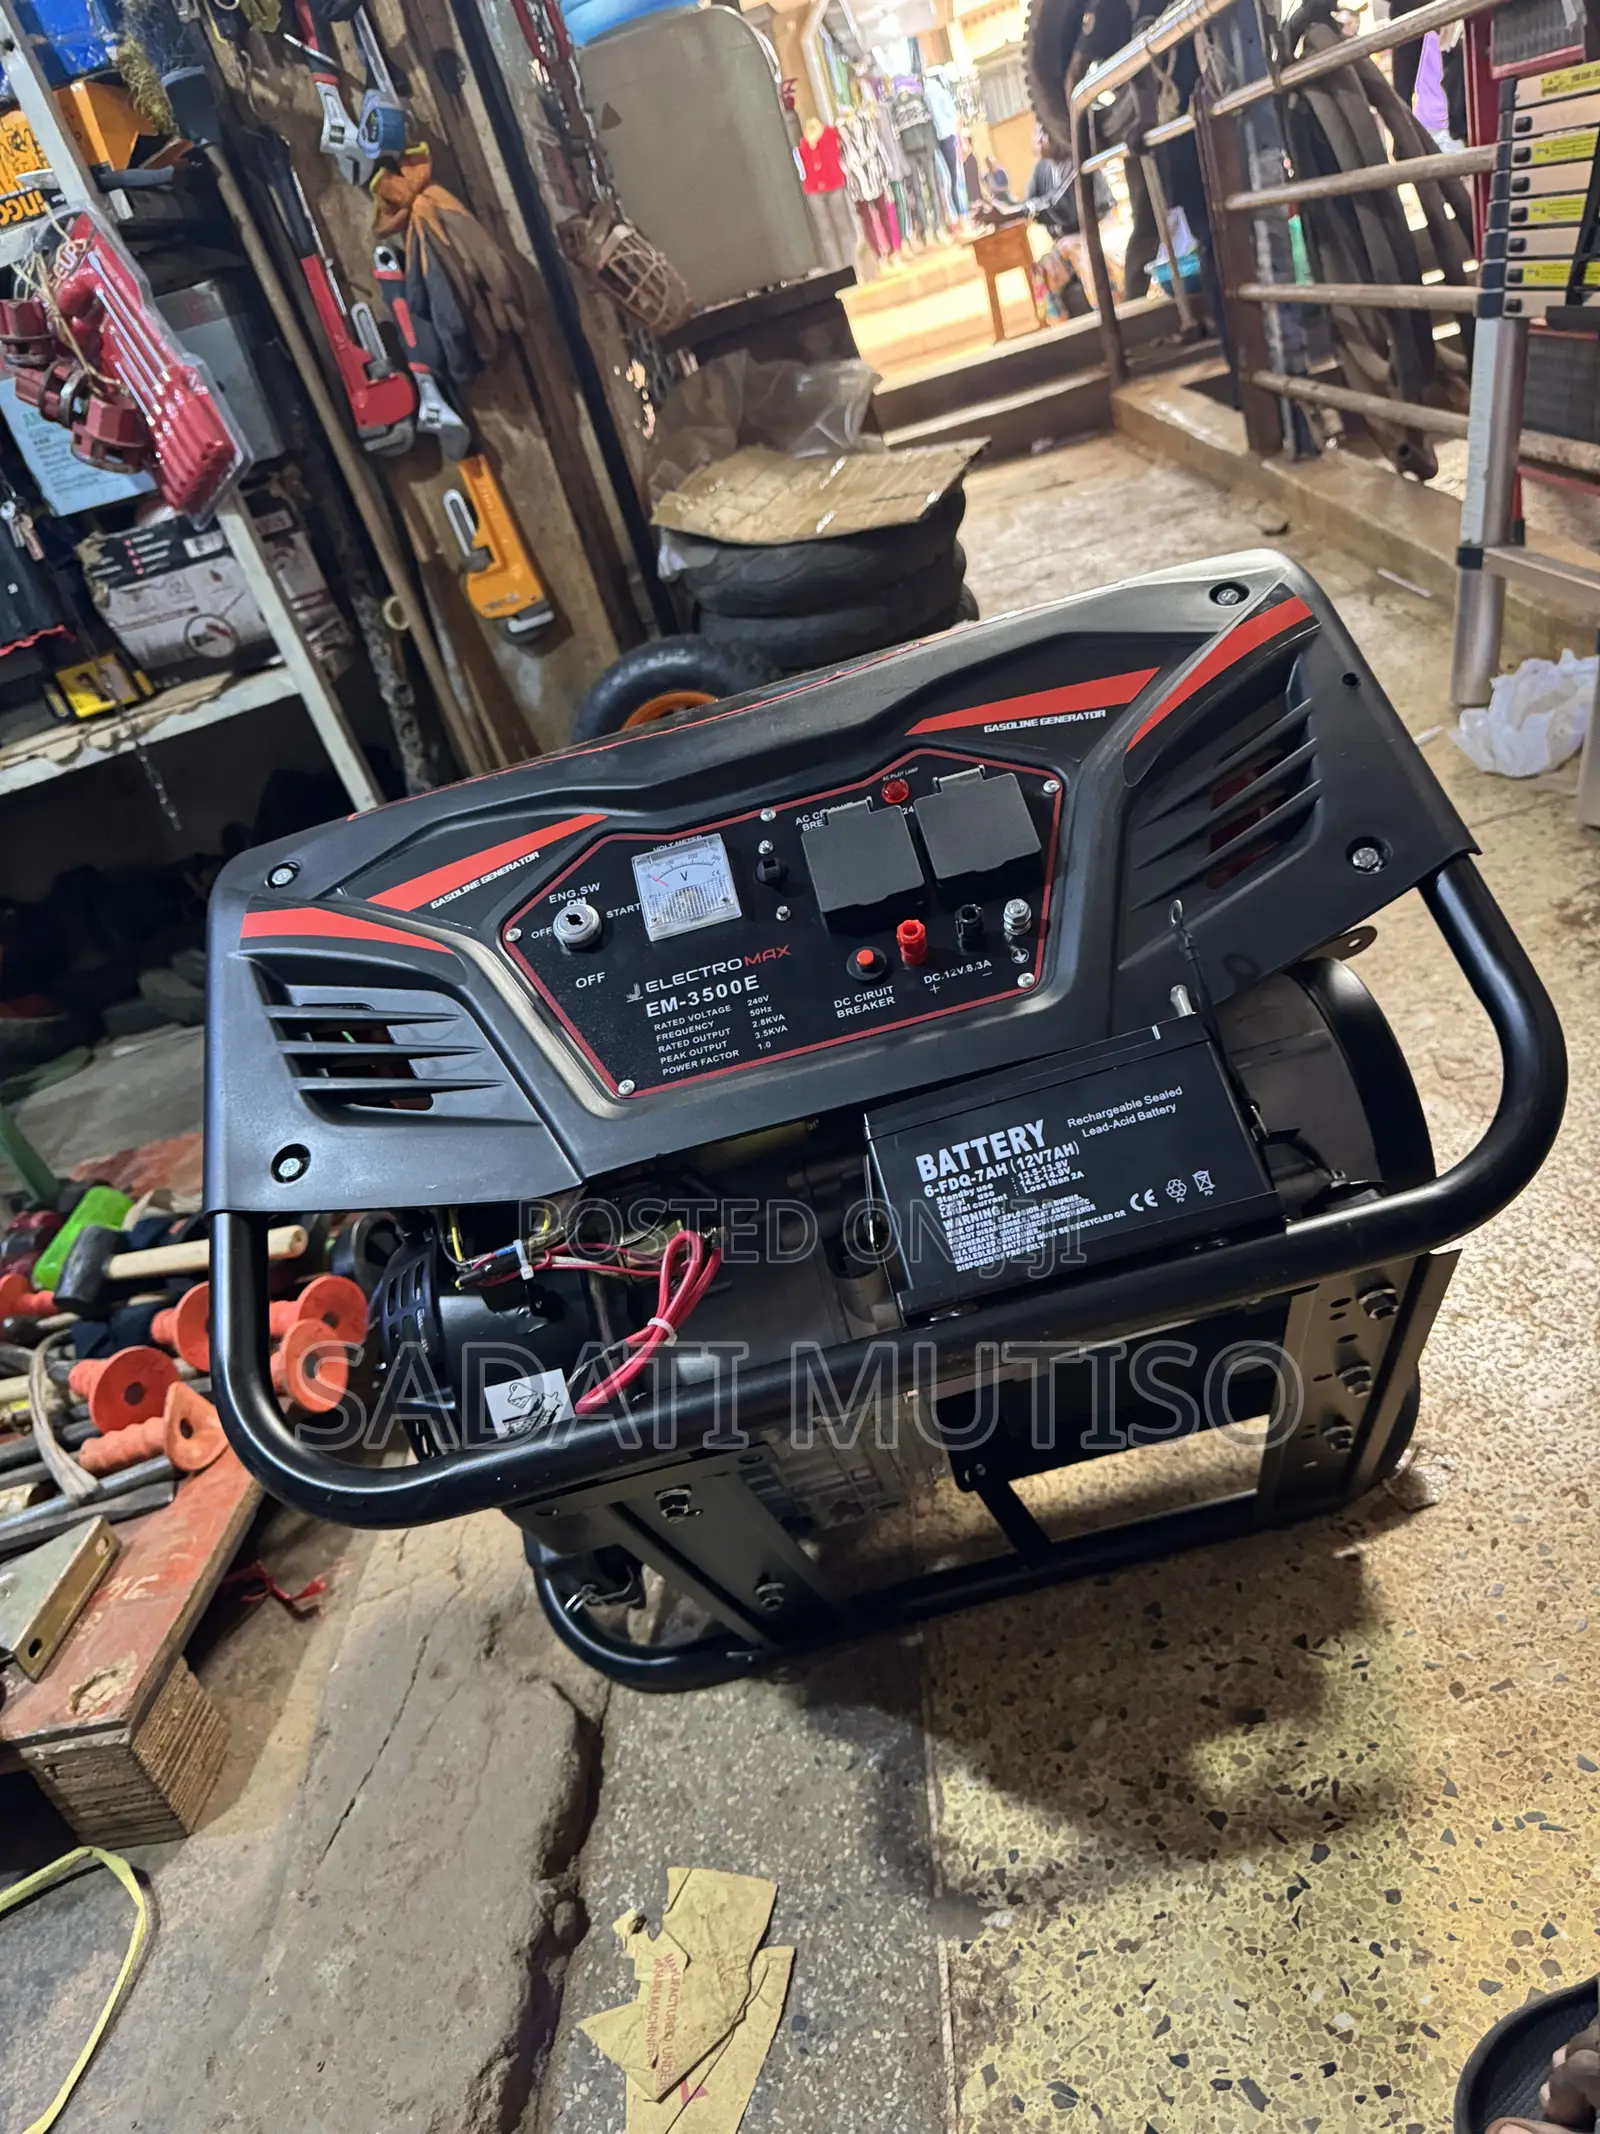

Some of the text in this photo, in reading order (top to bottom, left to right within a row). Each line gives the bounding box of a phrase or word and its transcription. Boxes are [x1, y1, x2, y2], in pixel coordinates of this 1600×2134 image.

[984, 709, 1106, 733] GASOLINE GENERATOR
[795, 814, 810, 825] AC
[430, 851, 540, 909] GASOLINE GENERATOR
[680, 870, 688, 881] V
[549, 882, 600, 904] ENG.SW
[606, 903, 641, 919] START
[531, 926, 552, 939] OFF
[575, 972, 606, 988] OFF
[646, 975, 760, 1018] EM-3500E
[834, 986, 894, 1009] DC CIRUIT
[836, 996, 896, 1019] BREAKER
[654, 995, 770, 1031] RATED VOLTAGE 240V
[656, 1006, 773, 1042] FREQUENCY 50Hz
[658, 1039, 690, 1054] RATED
[692, 1028, 731, 1044] OUTPUT
[660, 1025, 788, 1065] PEAK OUTPUT 3.5KVA
[662, 1042, 772, 1076] POWER FACTOR 1.0
[1067, 1086, 1183, 1128] Rechargeable Sealed
[1082, 1103, 1177, 1138] Lead-Acid Battery
[916, 1119, 1045, 1182] BATTERY
[924, 1162, 1008, 1197] 6-FDQ-7AH
[1047, 1175, 1070, 1187] than
[1070, 1170, 1085, 1180] 2A
[936, 1188, 974, 1205] Standby
[976, 1183, 993, 1193] use
[977, 1190, 995, 1200] use
[943, 1205, 1005, 1230] WARNING:
[1114, 1209, 1127, 1218] OR
